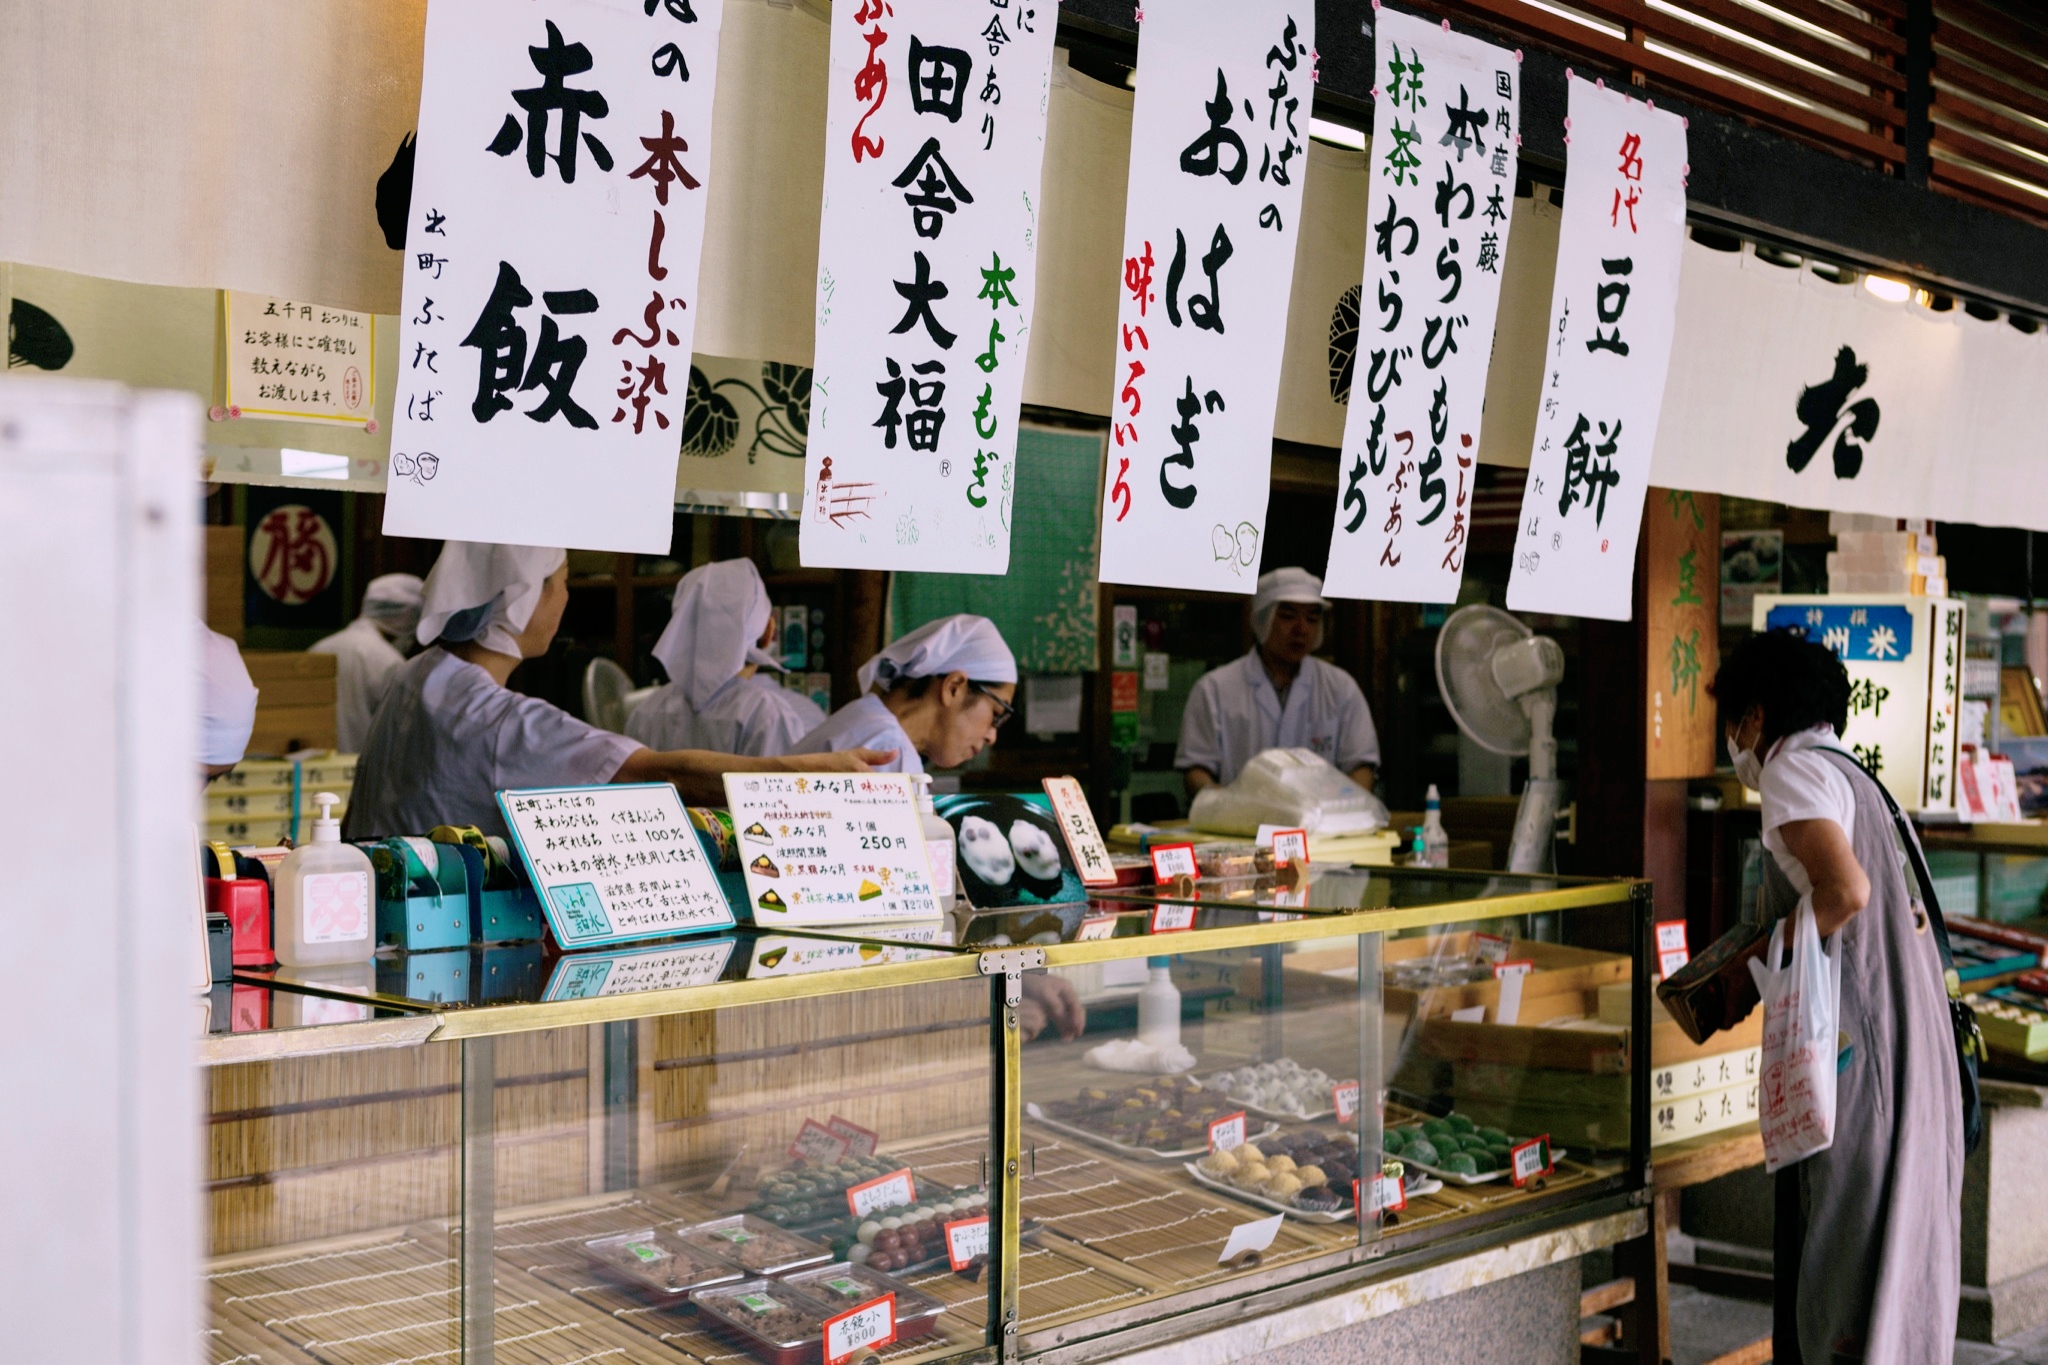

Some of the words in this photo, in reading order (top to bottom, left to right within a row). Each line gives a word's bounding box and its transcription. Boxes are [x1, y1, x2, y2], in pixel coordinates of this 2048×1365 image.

[1017, 0, 1036, 33] に
[1259, 14, 1306, 232] ふたばの
[1476, 70, 1512, 274] 国内産本蕨
[460, 19, 614, 430] 赤飯
[872, 34, 975, 452] 田舎大福
[1160, 67, 1253, 509] おはぎ
[244, 330, 358, 355] お客様にご確認し
[251, 356, 327, 382] 数えながら
[408, 209, 449, 423] 出町ふたば
[1416, 84, 1489, 526] 本わらびもち
[967, 251, 1019, 508] 本よもぎ
[1112, 241, 1155, 522] 味いろいろ
[1380, 431, 1414, 568] つぶあん
[1442, 434, 1474, 573] こしあん
[1527, 369, 1559, 536] 出町ふたば
[1789, 624, 1898, 660] 州米
[515, 796, 596, 812] 出町ふたばの
[534, 812, 599, 832] 本わらびもち
[611, 808, 666, 825] くずまんじゅう
[1930, 711, 1946, 800] ふたば
[545, 833, 602, 850] みぞれもち
[847, 1325, 876, 1347] ¥800
